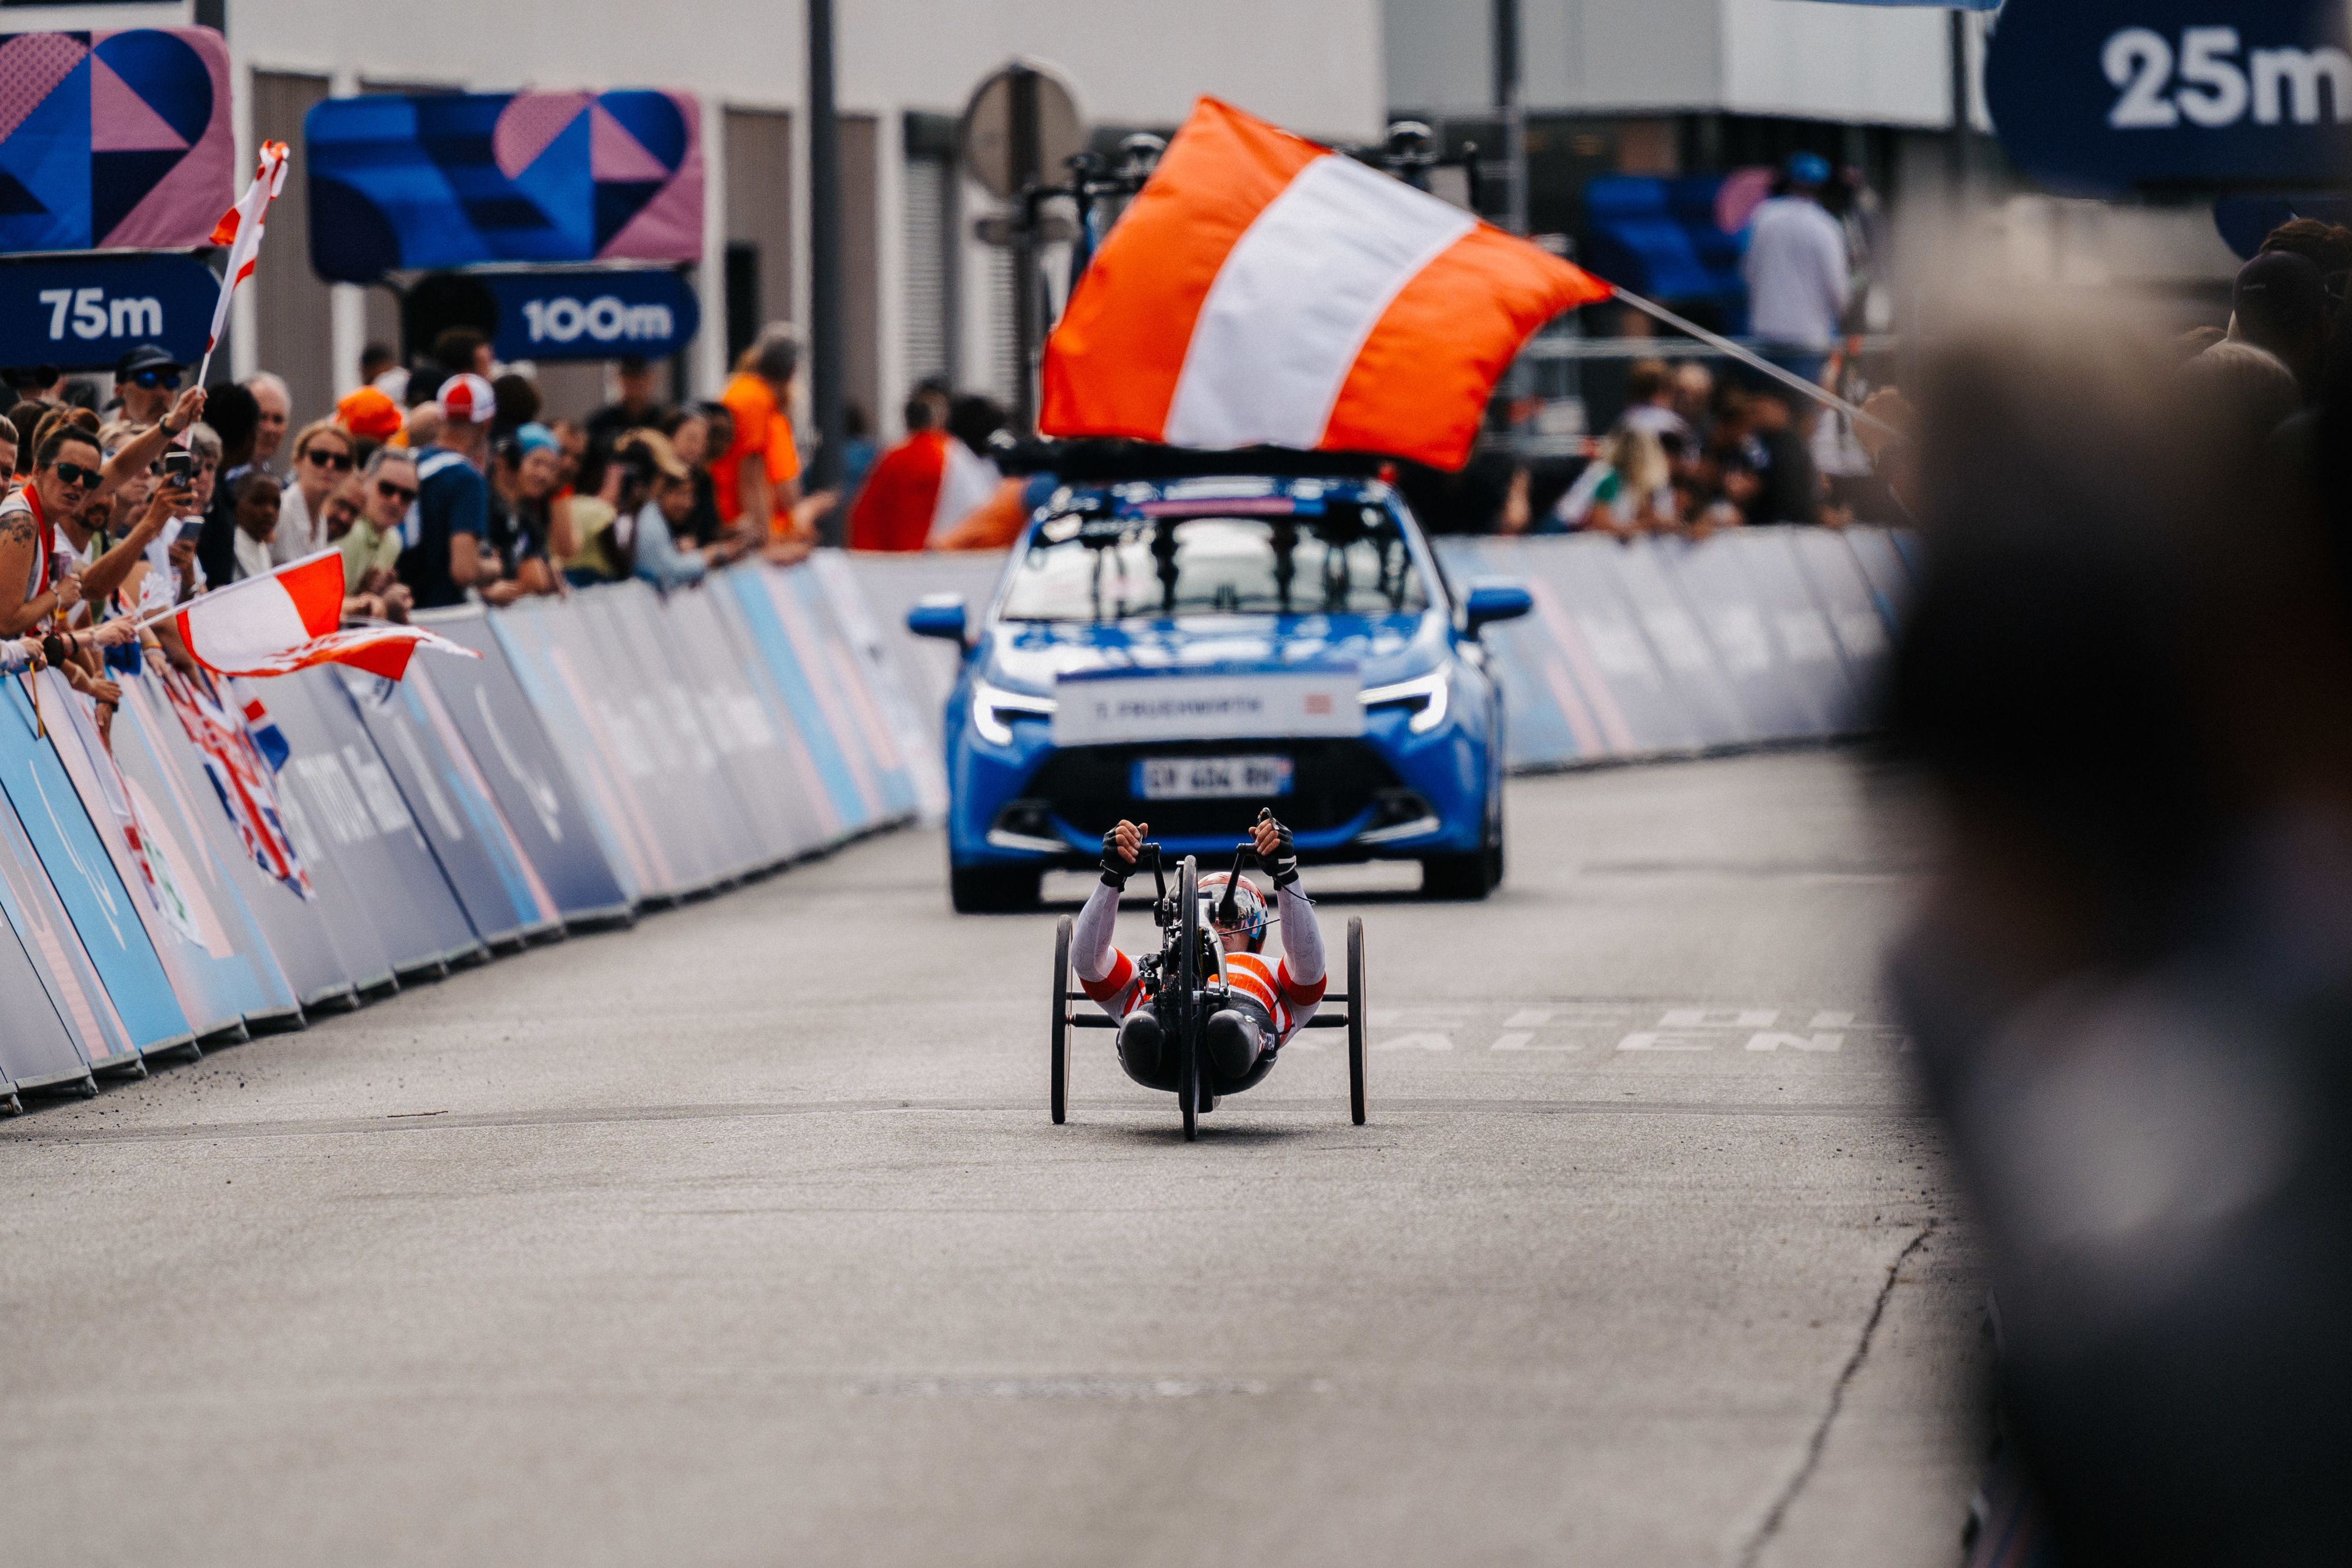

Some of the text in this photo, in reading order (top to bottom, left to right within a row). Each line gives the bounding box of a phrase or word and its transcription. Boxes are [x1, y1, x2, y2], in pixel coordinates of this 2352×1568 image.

[2102, 26, 2352, 128] 25m
[39, 287, 162, 341] 75m
[523, 296, 674, 342] 100m
